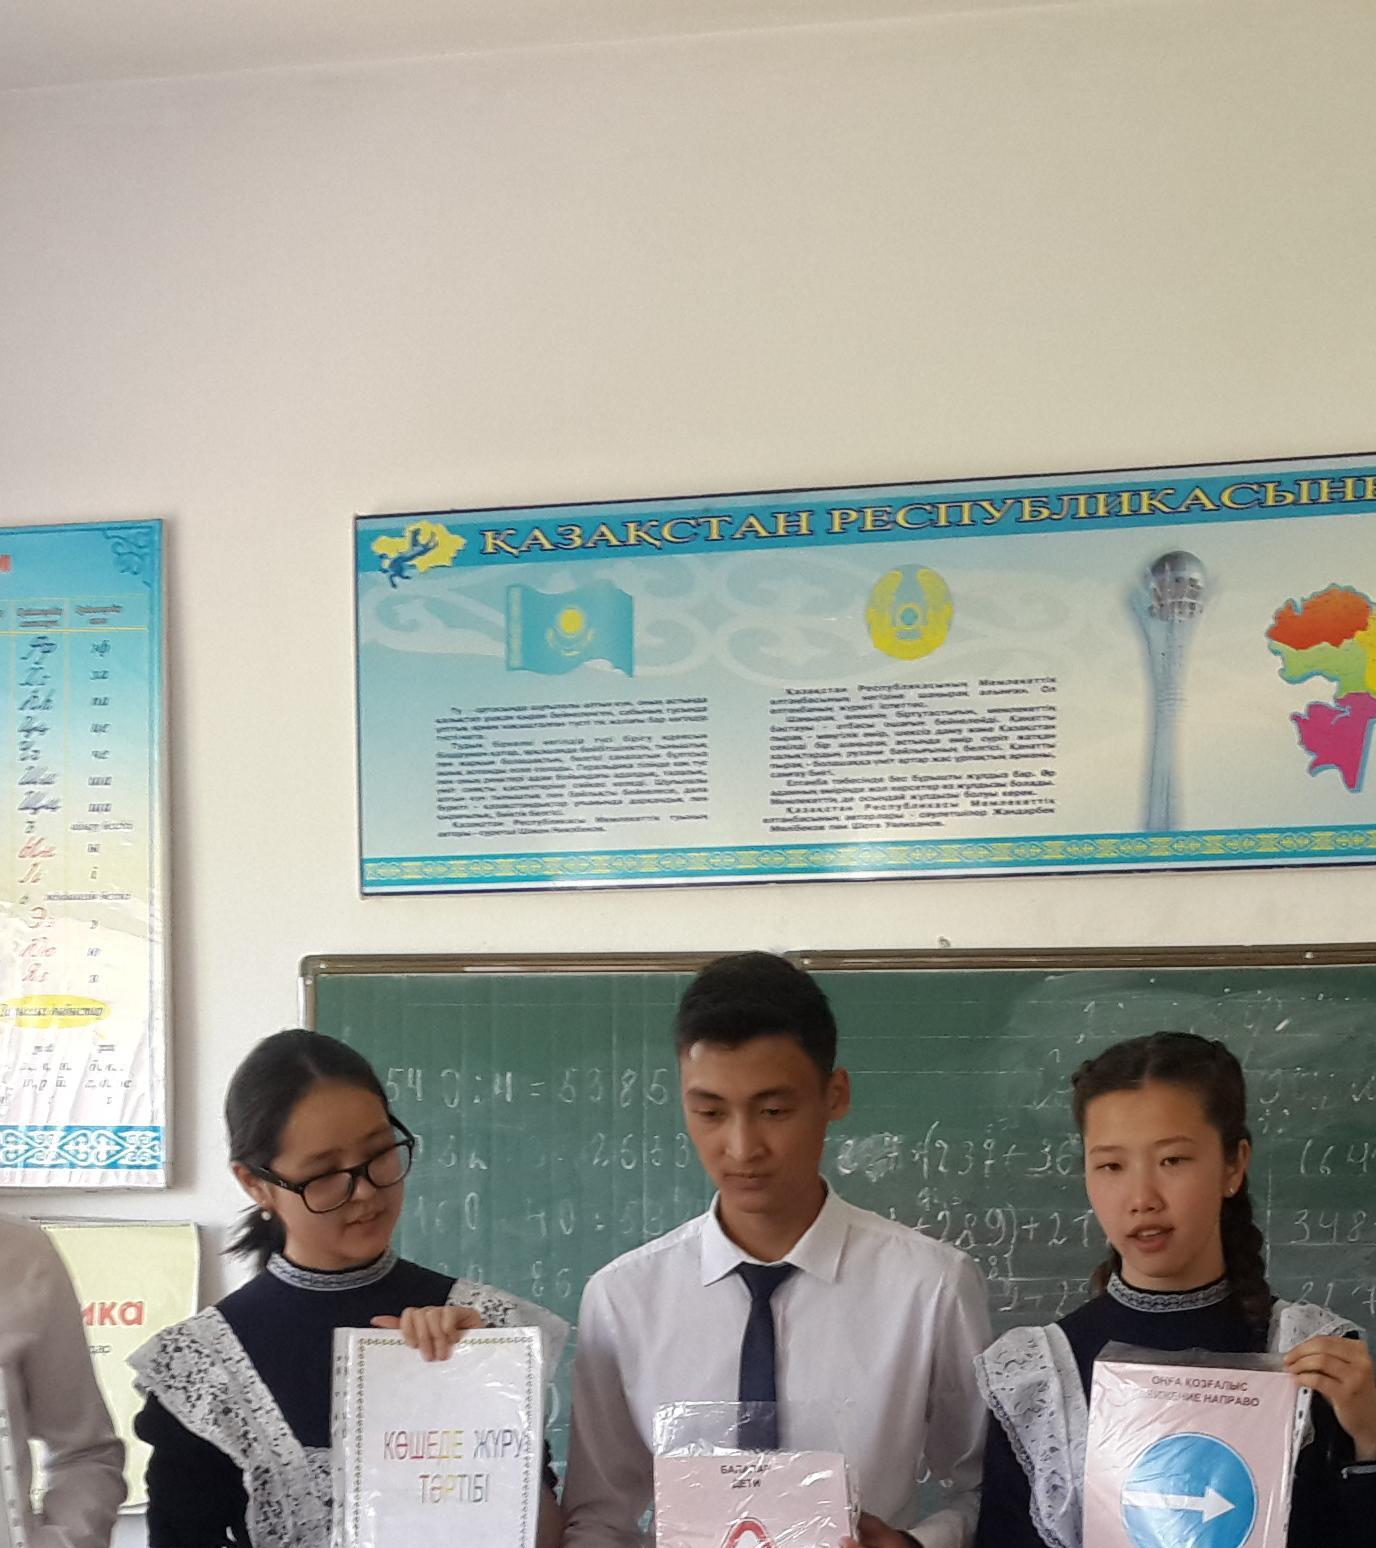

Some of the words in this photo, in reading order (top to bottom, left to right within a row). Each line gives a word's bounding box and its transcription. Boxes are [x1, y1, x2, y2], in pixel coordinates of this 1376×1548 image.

[480, 511, 814, 555] ҚАЗАҚСТАН
[1203, 1393, 1261, 1407] НАПРАВО
[384, 1430, 464, 1463] КӨШЕДЕ
[731, 1478, 762, 1489] ДЕТИ
